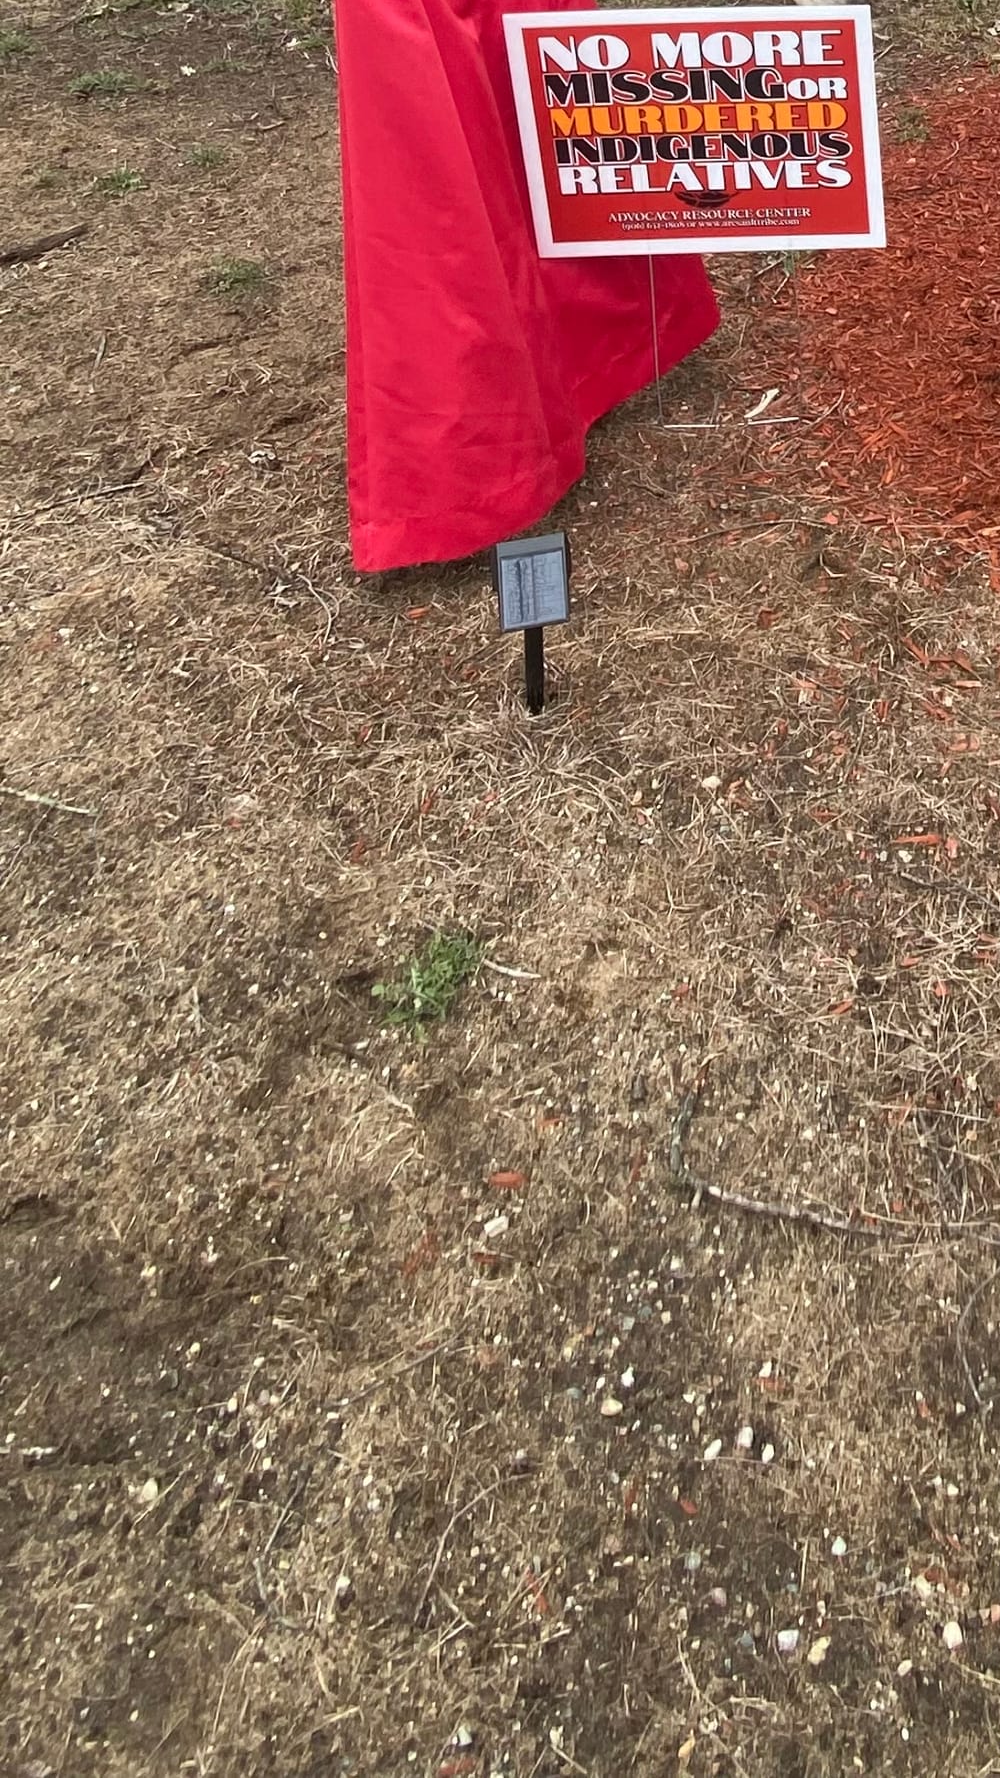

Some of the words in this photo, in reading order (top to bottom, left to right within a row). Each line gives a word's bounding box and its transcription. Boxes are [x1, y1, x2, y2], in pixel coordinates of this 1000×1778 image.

[537, 33, 630, 72] NO
[651, 29, 845, 69] MORE
[544, 68, 787, 107] MISSING
[787, 77, 847, 101] OR
[551, 102, 848, 137] MURDERED
[553, 131, 854, 165] INDIGENOUS
[557, 159, 853, 195] RELATIVES
[608, 210, 679, 223] ADVOCACY
[682, 208, 754, 221] RESOURCE
[756, 207, 812, 218] CENTER
